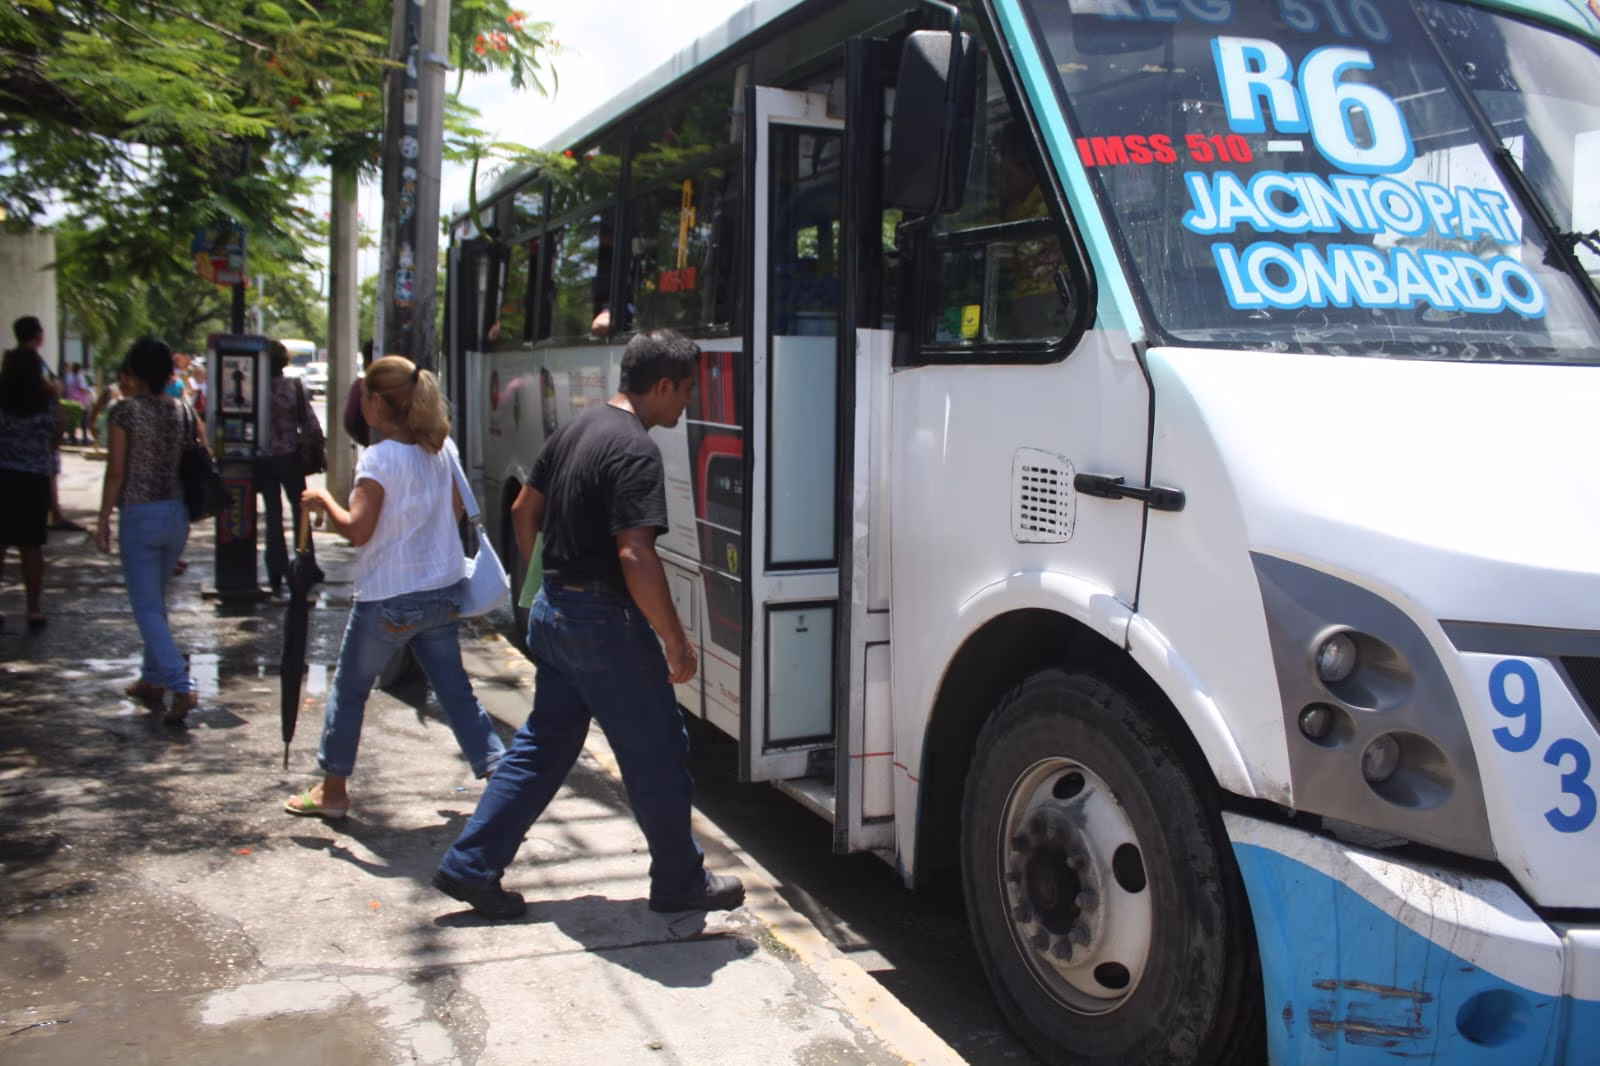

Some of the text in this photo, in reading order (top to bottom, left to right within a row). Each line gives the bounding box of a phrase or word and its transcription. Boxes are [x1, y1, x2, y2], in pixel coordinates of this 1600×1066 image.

[1076, 134, 1253, 167] IMSS 510
[1182, 171, 1520, 246] JACINTO PAT
[1211, 241, 1547, 318] LOMBARDO
